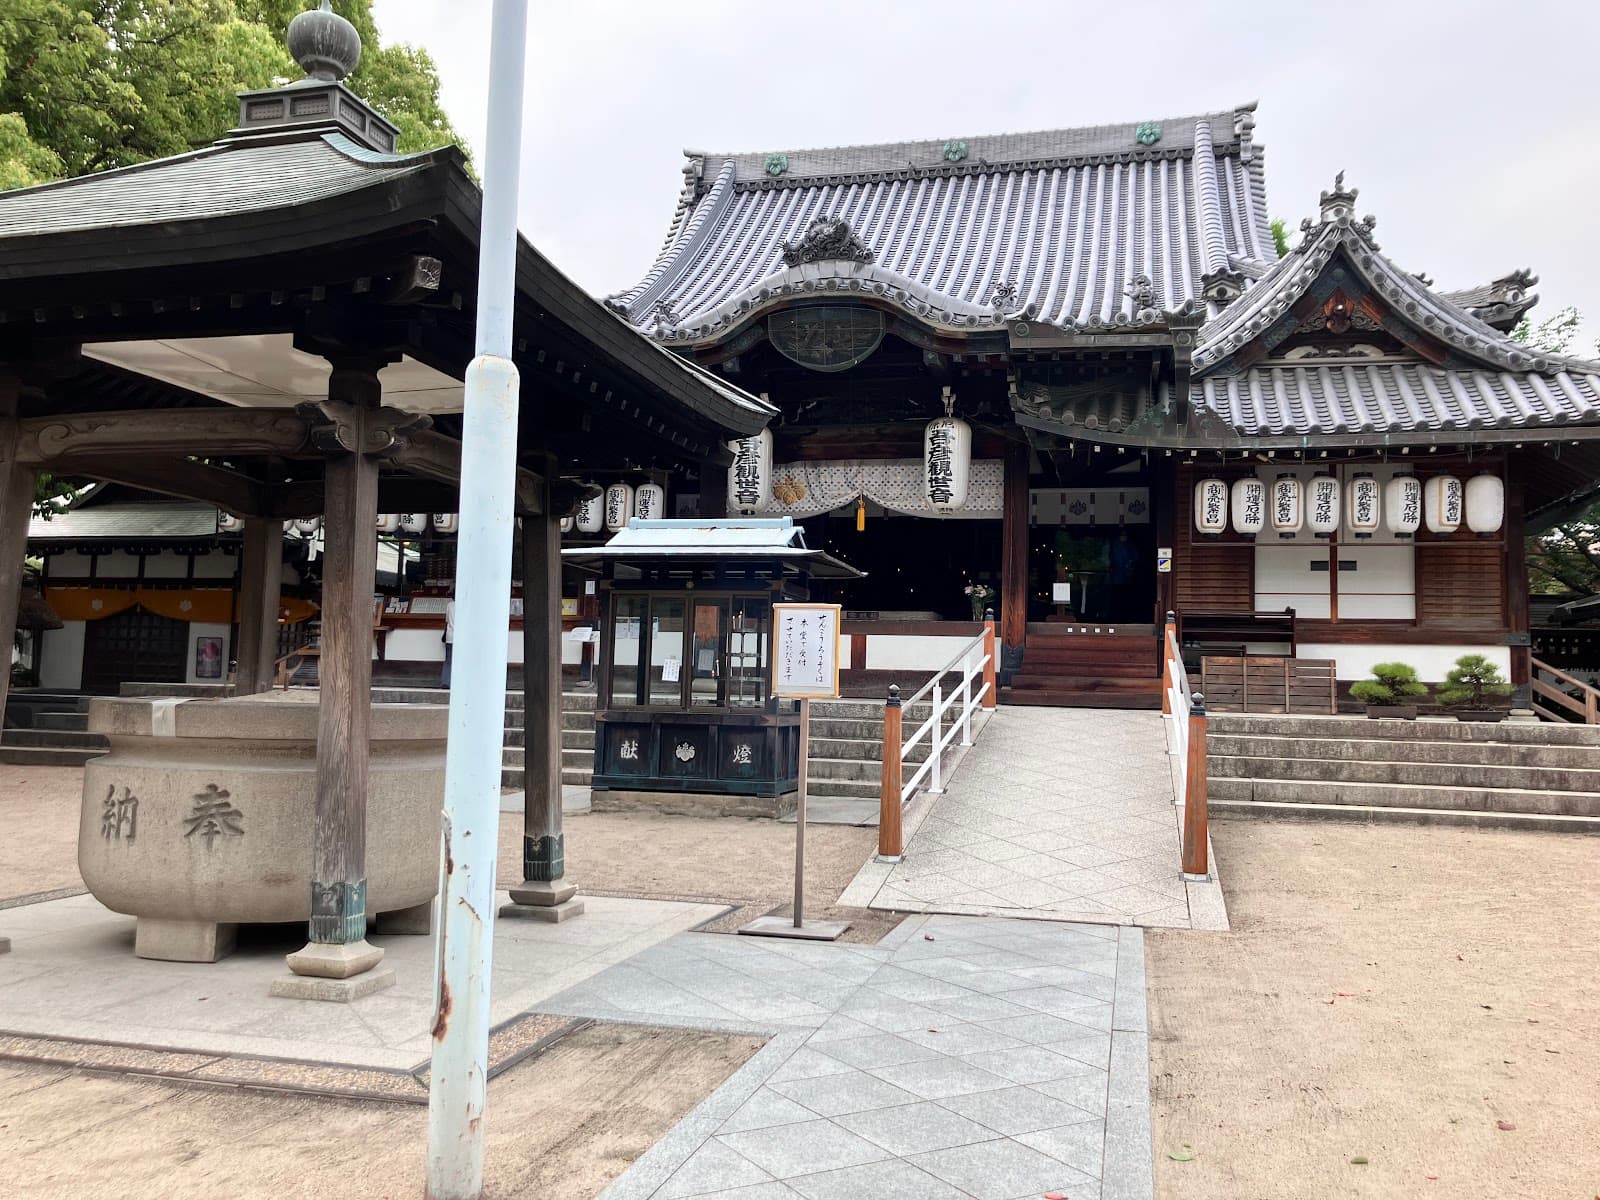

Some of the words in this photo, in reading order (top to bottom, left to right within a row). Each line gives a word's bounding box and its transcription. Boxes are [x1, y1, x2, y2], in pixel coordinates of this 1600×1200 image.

[620, 740, 639, 759] 献
[101, 784, 139, 841] 納
[183, 782, 245, 850] 奉
